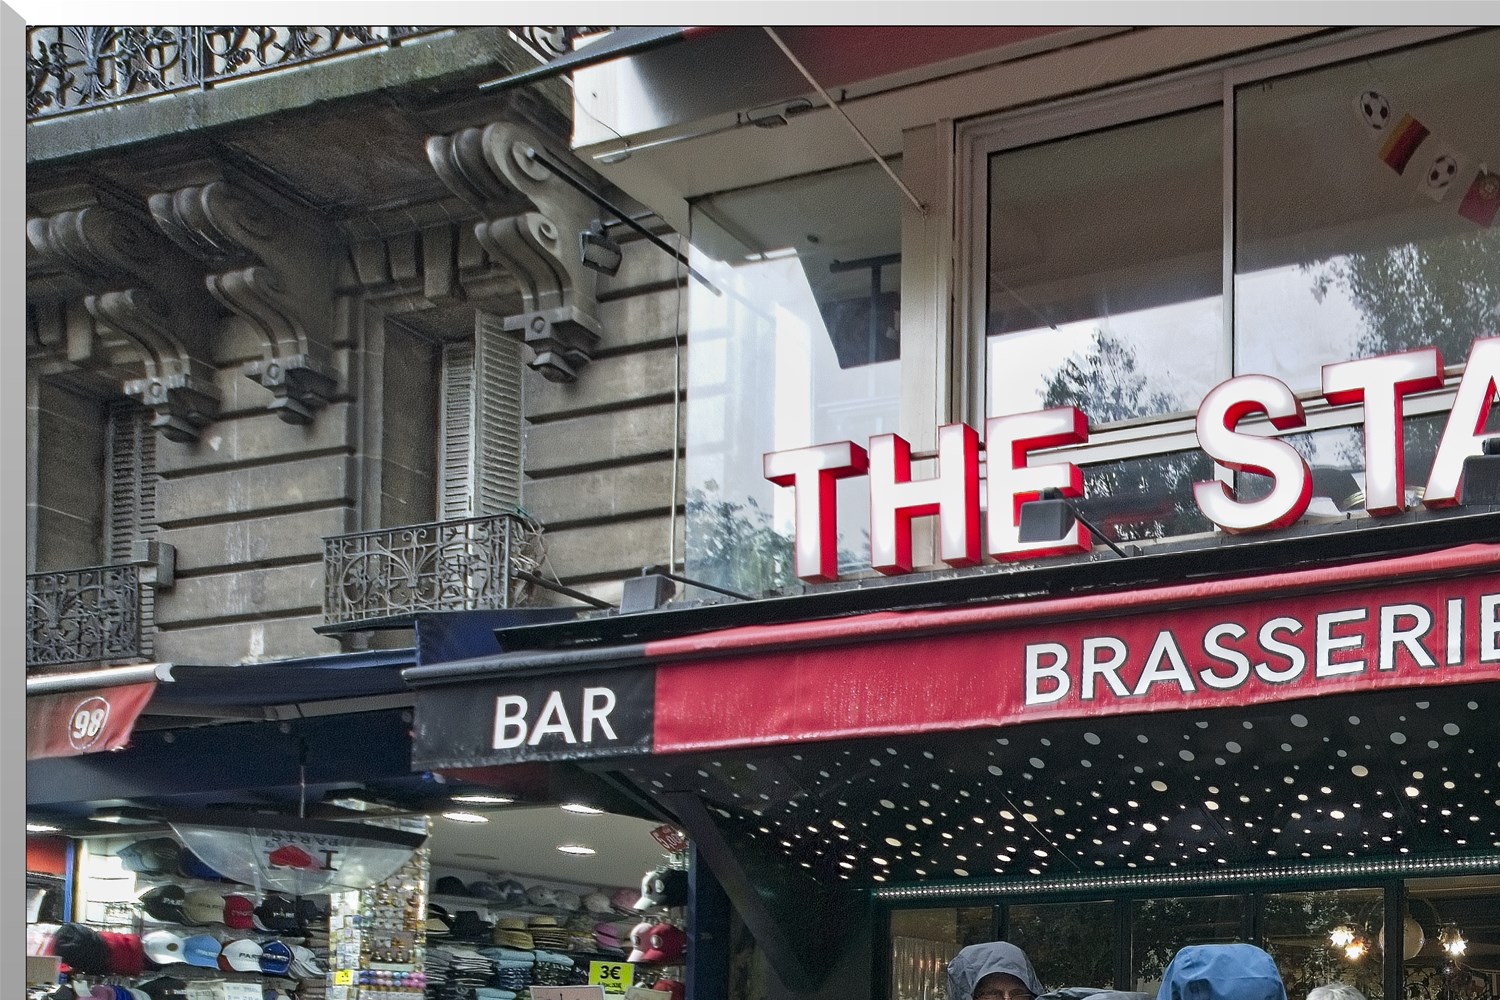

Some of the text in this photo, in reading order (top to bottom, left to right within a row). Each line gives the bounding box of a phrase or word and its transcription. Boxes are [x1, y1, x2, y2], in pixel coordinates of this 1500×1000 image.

[763, 405, 1093, 583] THE
[73, 708, 105, 739] 98
[493, 686, 619, 750] BAR
[600, 965, 622, 980] 3€
